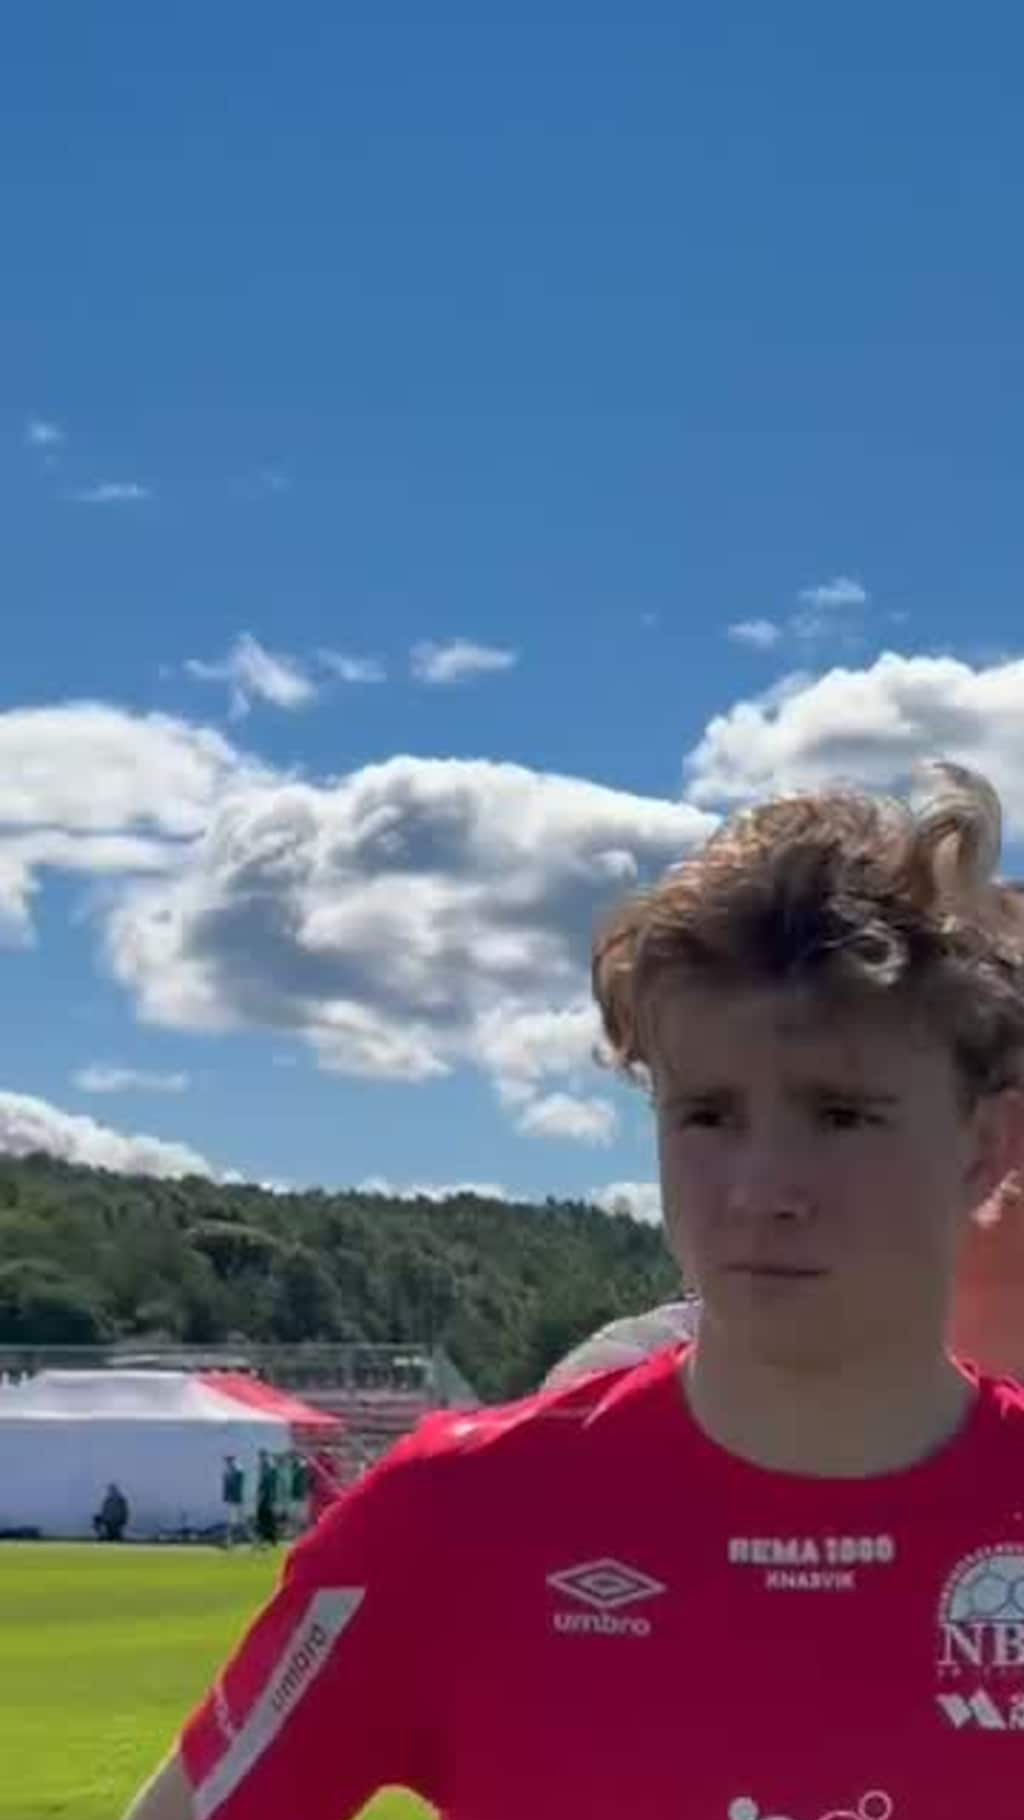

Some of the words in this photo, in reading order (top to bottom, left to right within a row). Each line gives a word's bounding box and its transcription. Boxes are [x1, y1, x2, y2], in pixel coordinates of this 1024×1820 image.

[728, 1537, 820, 1565] REMA
[824, 1533, 895, 1564] 1000
[553, 1610, 652, 1637] umbro
[271, 1623, 328, 1713] umbro
